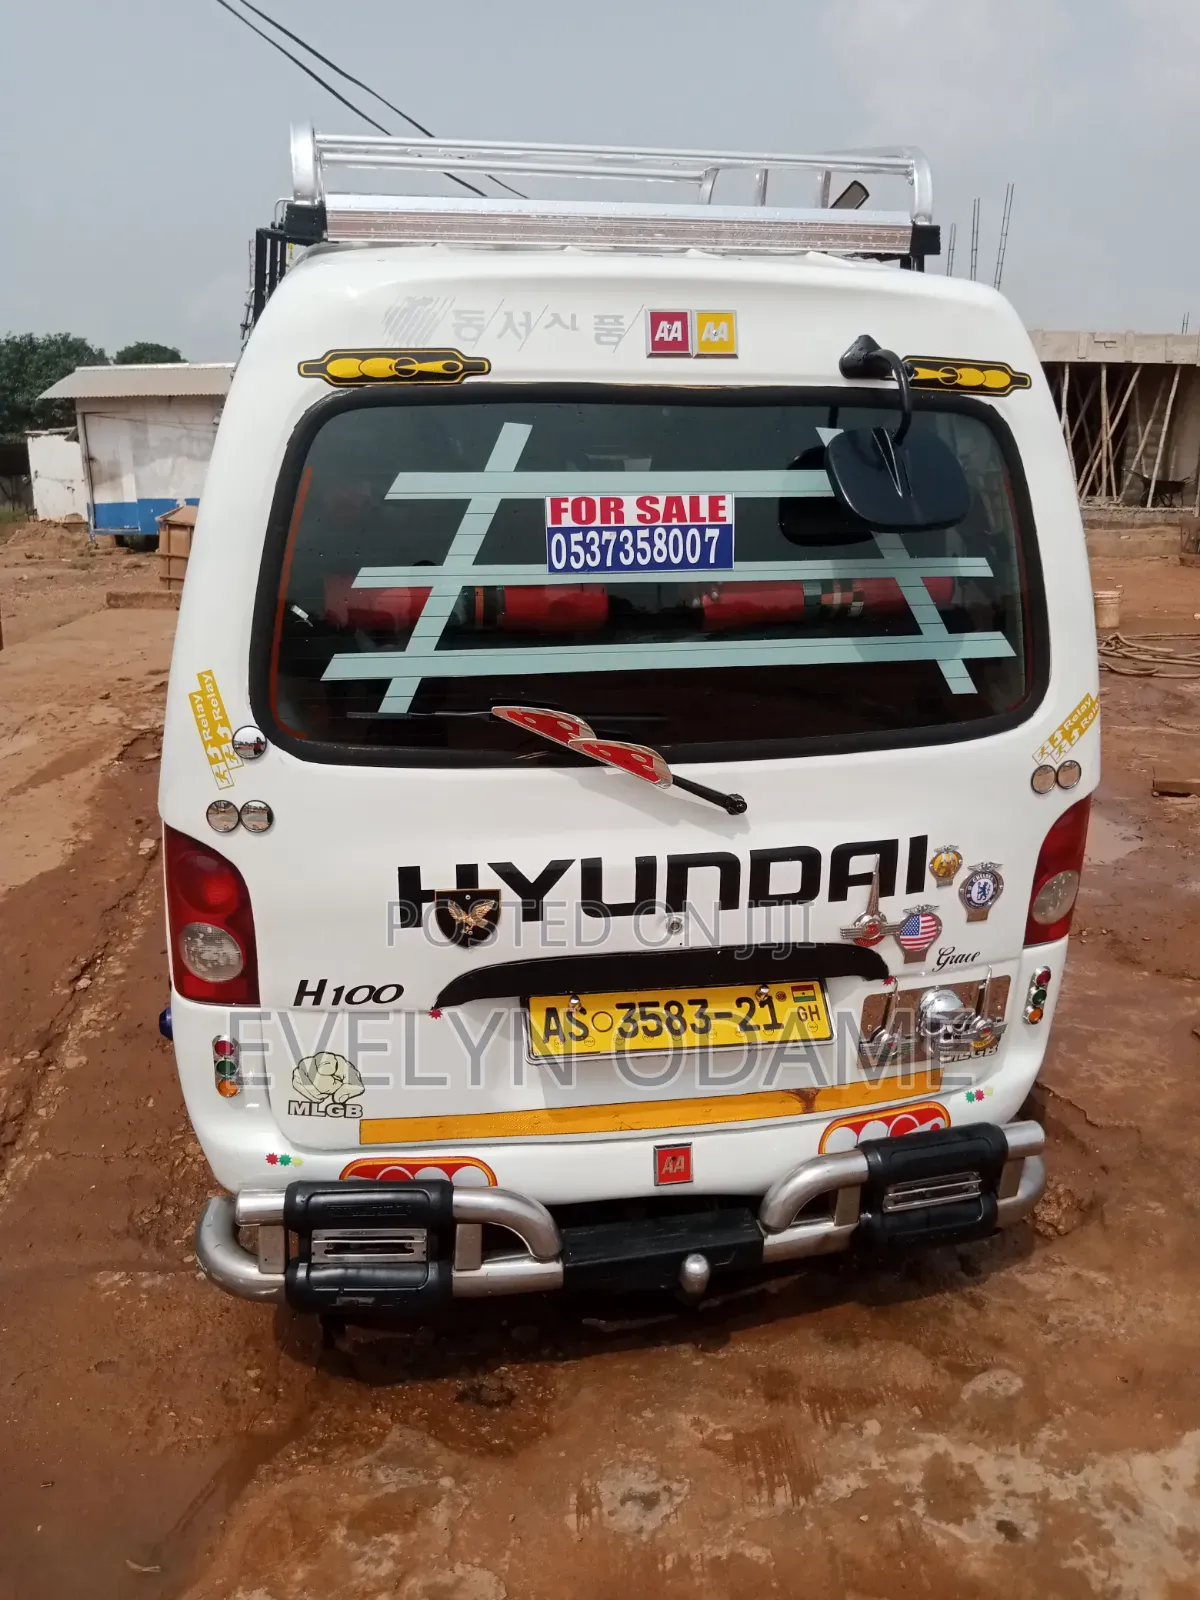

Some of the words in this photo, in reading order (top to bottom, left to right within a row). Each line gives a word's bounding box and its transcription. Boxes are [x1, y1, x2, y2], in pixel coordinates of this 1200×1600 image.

[654, 320, 683, 342] AA
[701, 321, 729, 342] AA
[550, 496, 625, 526] FOR
[635, 494, 727, 524] SALE
[550, 526, 720, 570] 0537358007
[202, 673, 223, 721] Relay
[193, 694, 213, 741] Relay
[1063, 696, 1091, 730] Relay
[398, 834, 928, 929] HYUNDAI
[932, 945, 980, 972] Grace
[293, 978, 405, 1007] H100
[543, 1006, 590, 1042] AS
[615, 995, 784, 1039] 3583-21
[796, 1004, 821, 1023] GH
[288, 1100, 364, 1119] MLGB
[660, 1155, 686, 1175] AA
